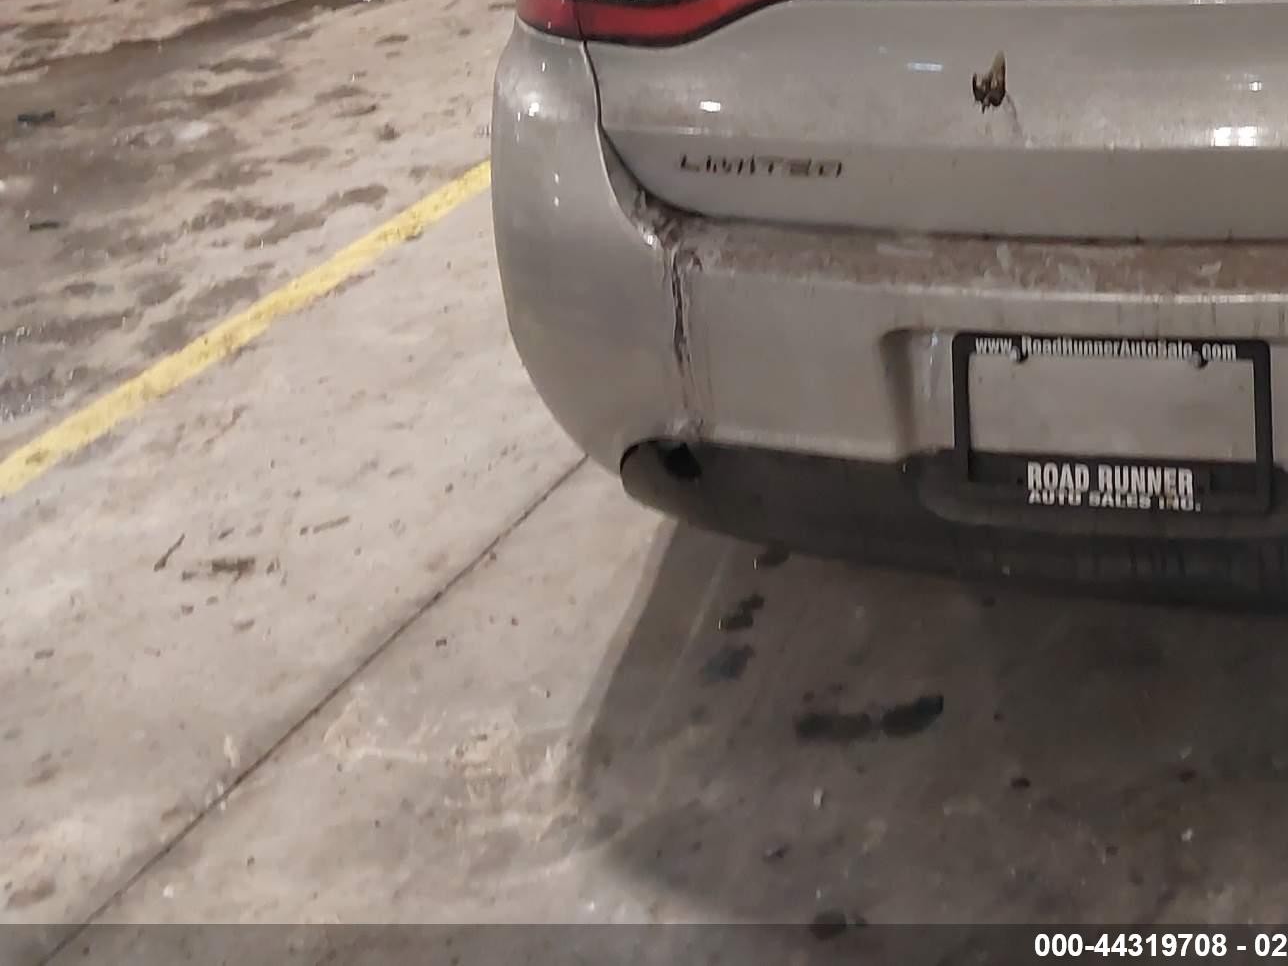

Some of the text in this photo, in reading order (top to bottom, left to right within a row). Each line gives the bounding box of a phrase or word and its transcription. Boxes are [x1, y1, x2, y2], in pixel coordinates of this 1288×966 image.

[680, 153, 842, 178] LIMITED
[1027, 461, 1194, 498] ROAD RUNNER
[1028, 490, 1082, 506] AUTO
[1089, 491, 1151, 509] SALES
